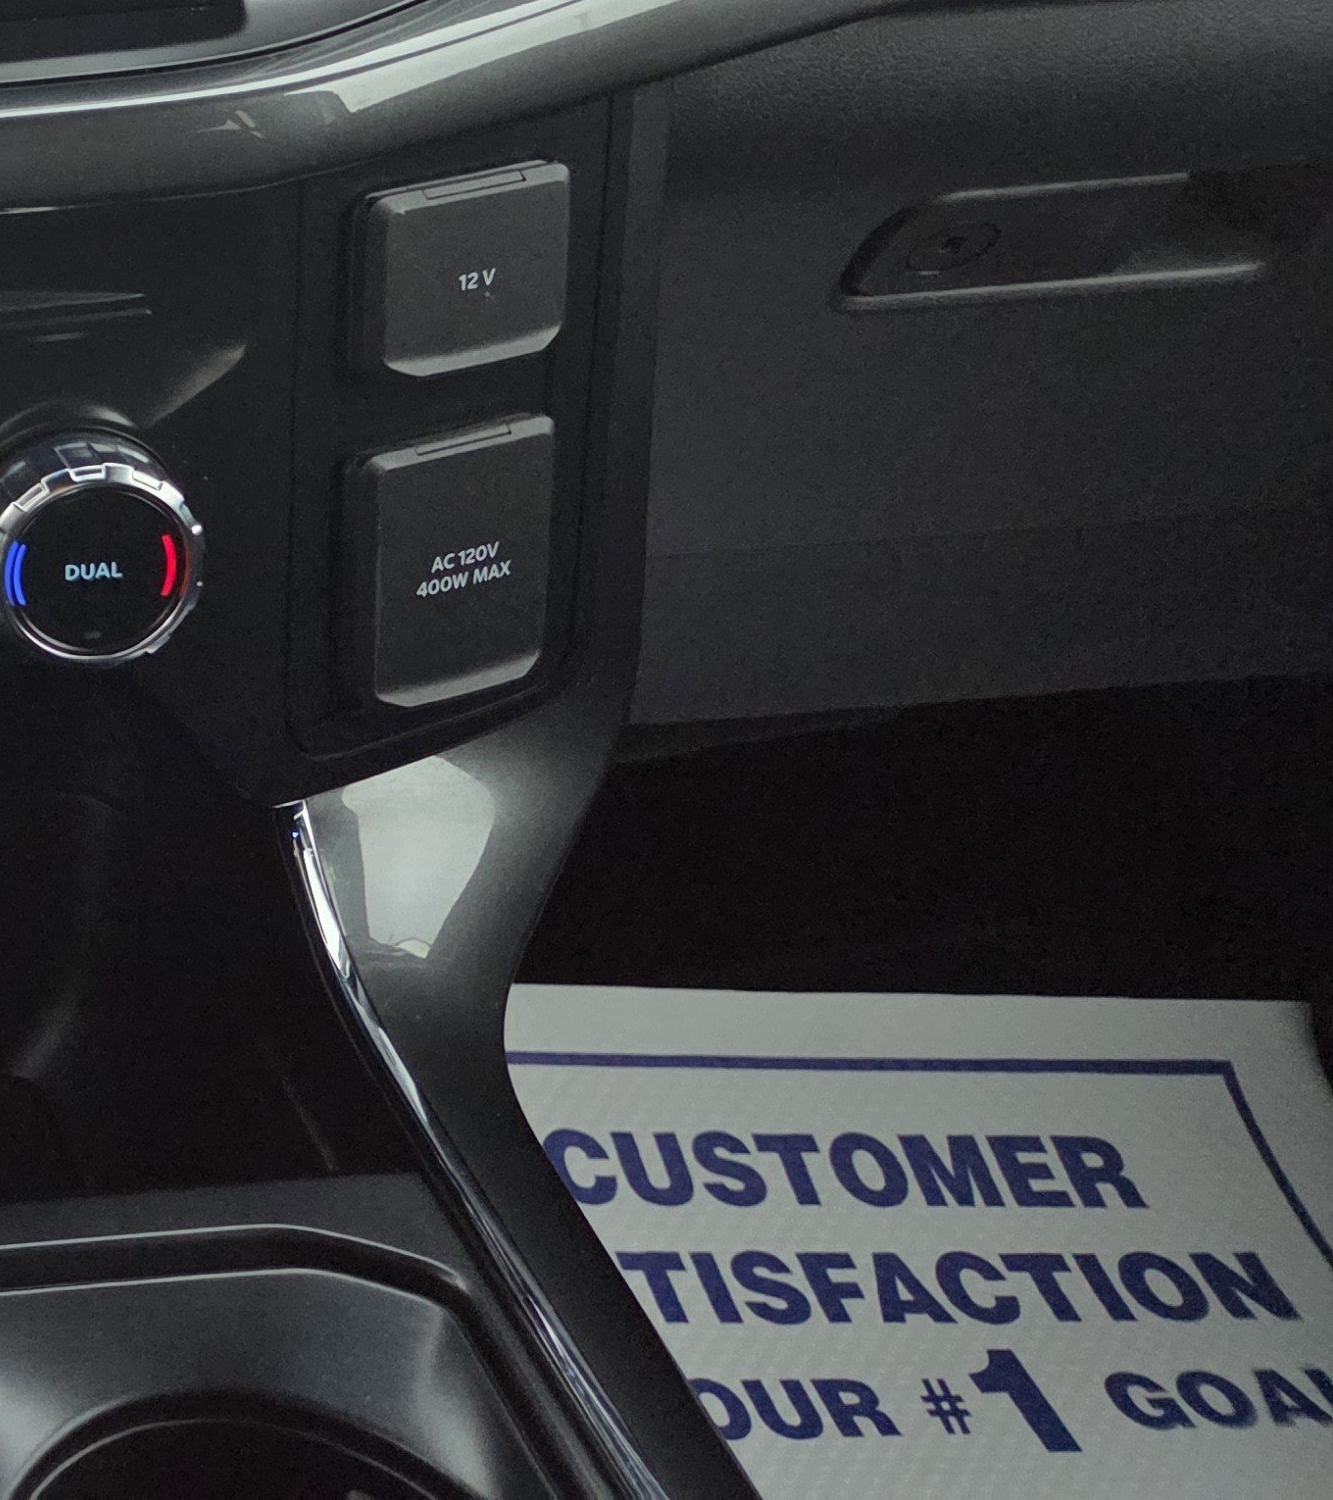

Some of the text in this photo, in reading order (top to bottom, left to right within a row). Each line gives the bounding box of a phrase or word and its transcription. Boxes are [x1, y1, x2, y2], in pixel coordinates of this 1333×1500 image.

[458, 267, 497, 292] 12 V
[64, 561, 123, 582] DUAL
[431, 541, 501, 573] AC 120V
[416, 560, 511, 597] 400W MAX
[542, 1128, 1149, 1208] CUSTOMER
